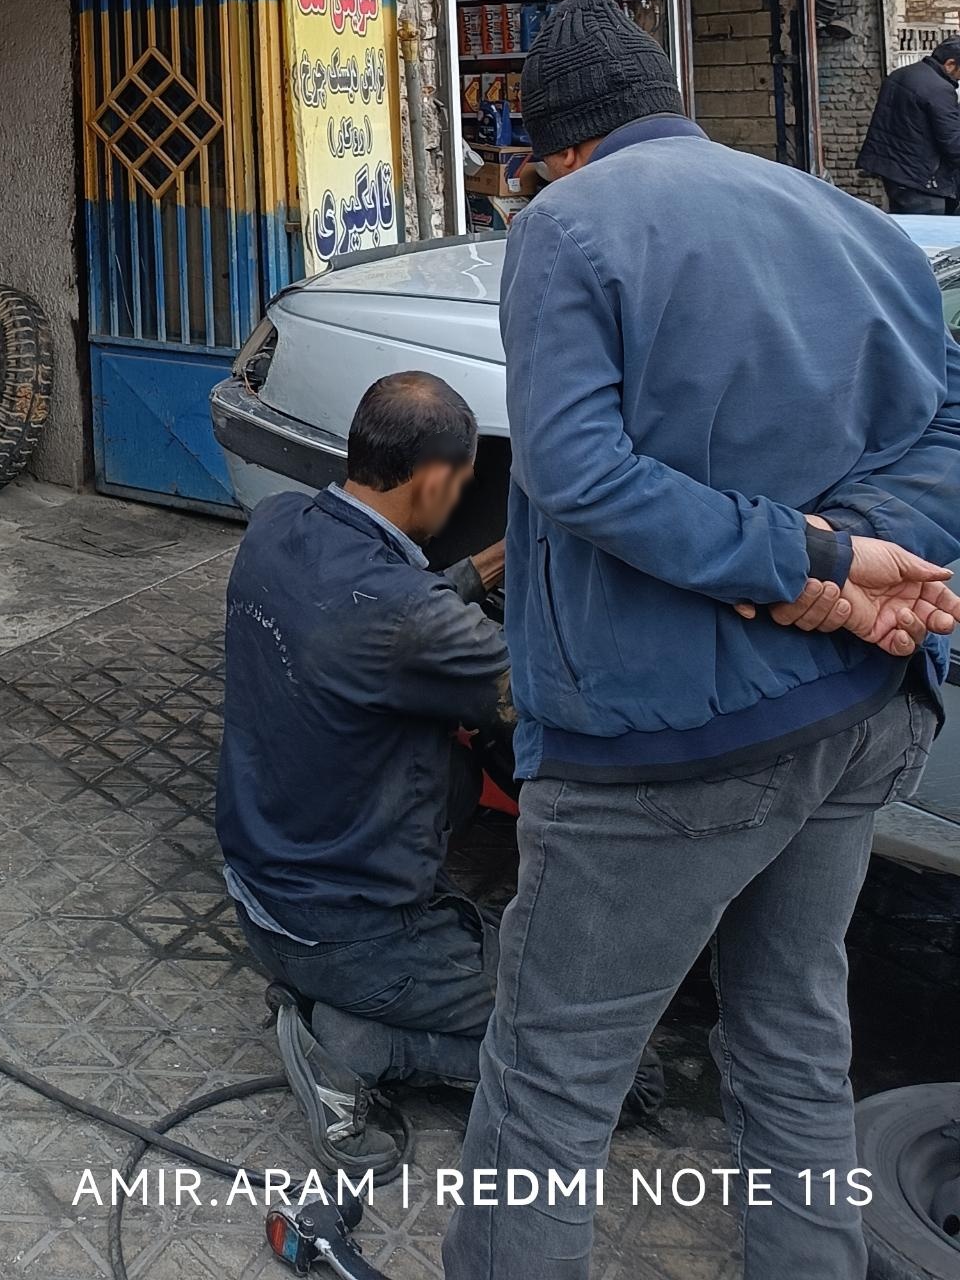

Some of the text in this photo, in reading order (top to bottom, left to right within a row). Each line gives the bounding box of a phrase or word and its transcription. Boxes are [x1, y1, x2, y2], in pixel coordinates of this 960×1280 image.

[300, 48, 386, 107] تراش دیسک چرخ
